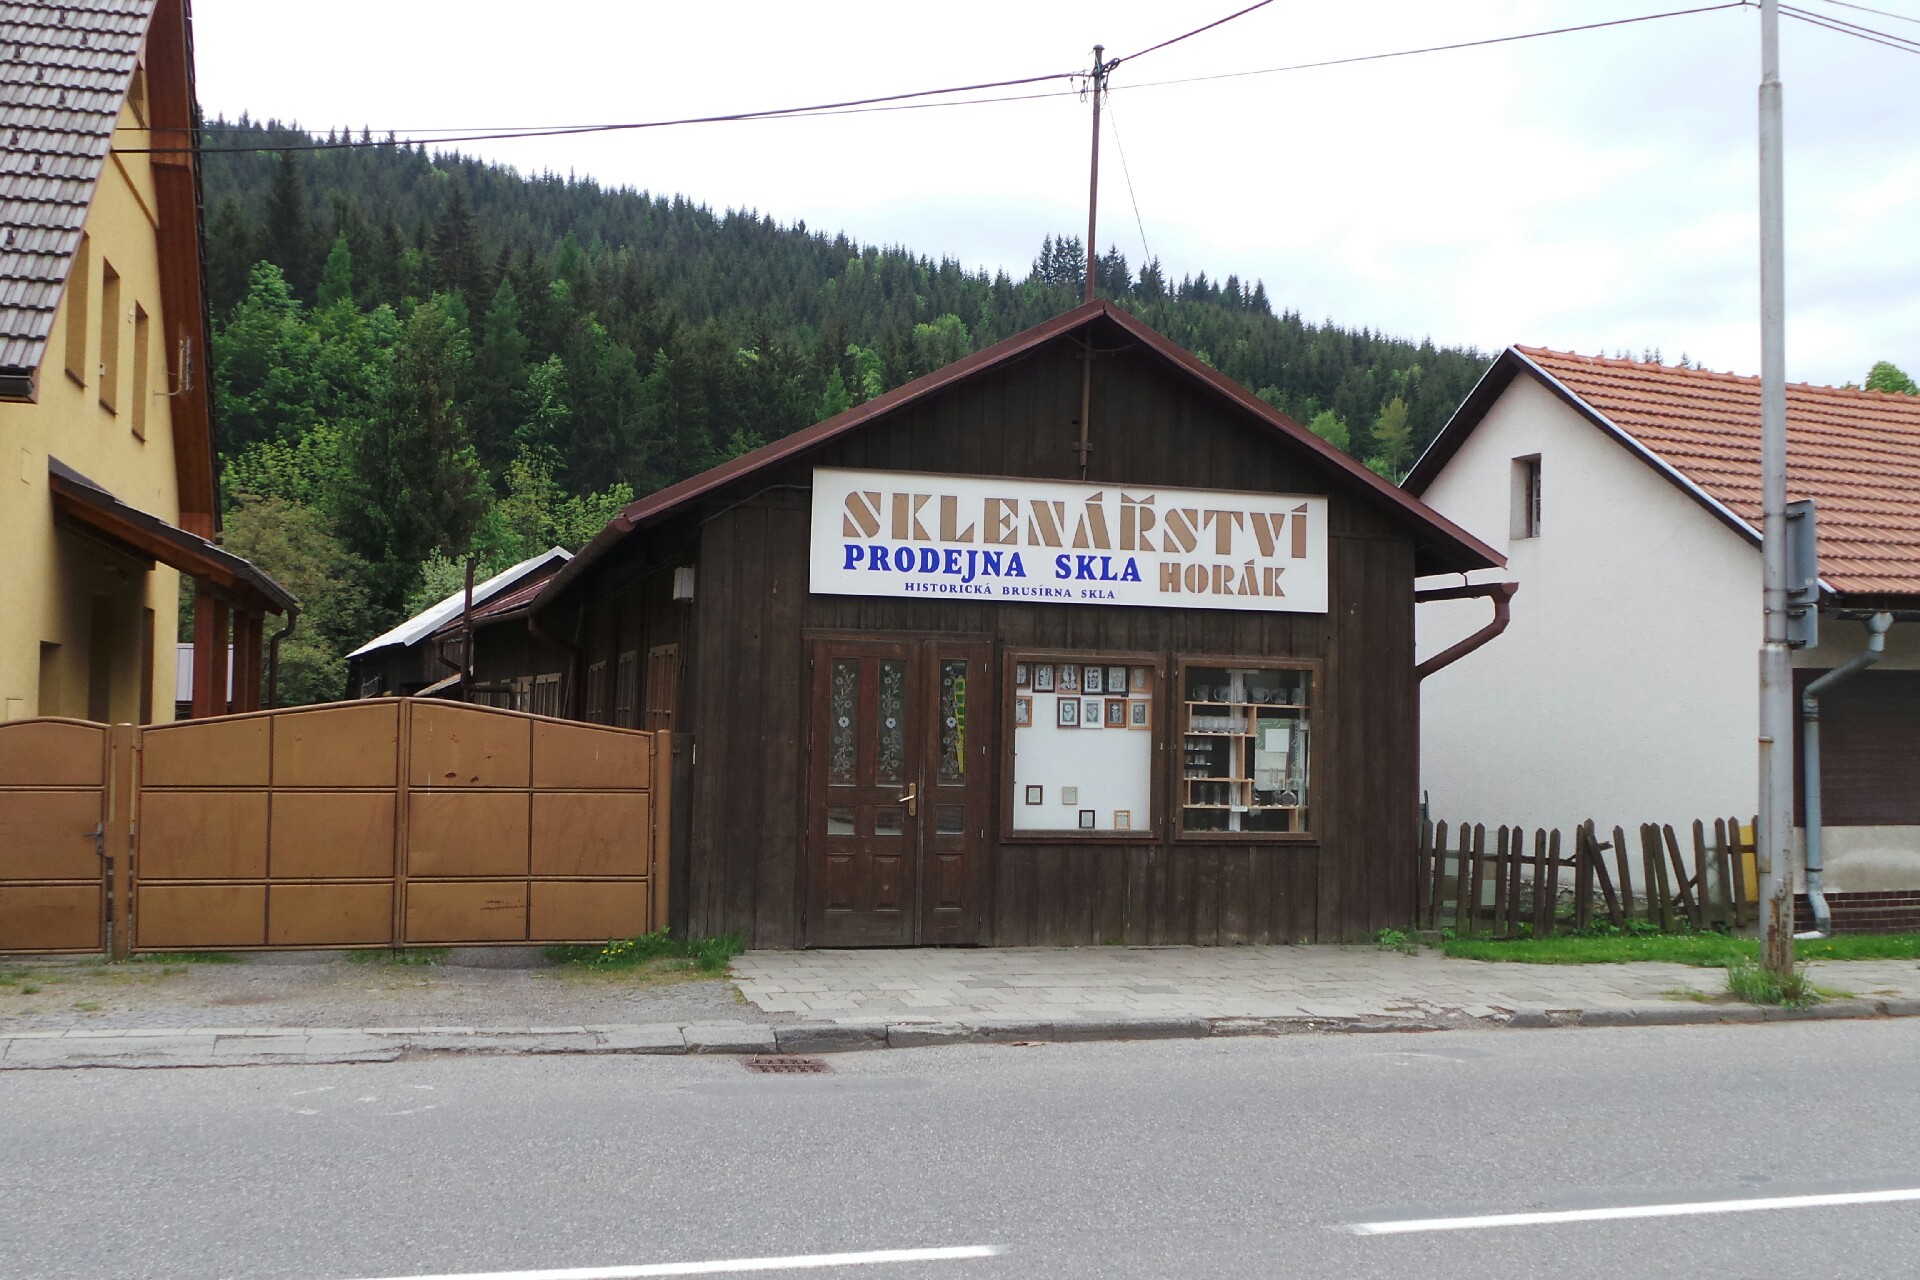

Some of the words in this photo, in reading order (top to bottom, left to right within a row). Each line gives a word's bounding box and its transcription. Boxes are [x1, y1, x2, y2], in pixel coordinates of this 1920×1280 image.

[843, 491, 1308, 558] SKLENÁŘSTVÍ
[843, 544, 1026, 583] PRODEJNA
[1055, 553, 1142, 582] SKLA
[1159, 559, 1286, 597] HORÁK
[904, 582, 992, 595] HISTORICKÁ
[1002, 584, 1072, 598] BRUSÍRNA
[1081, 589, 1115, 600] SKLA
